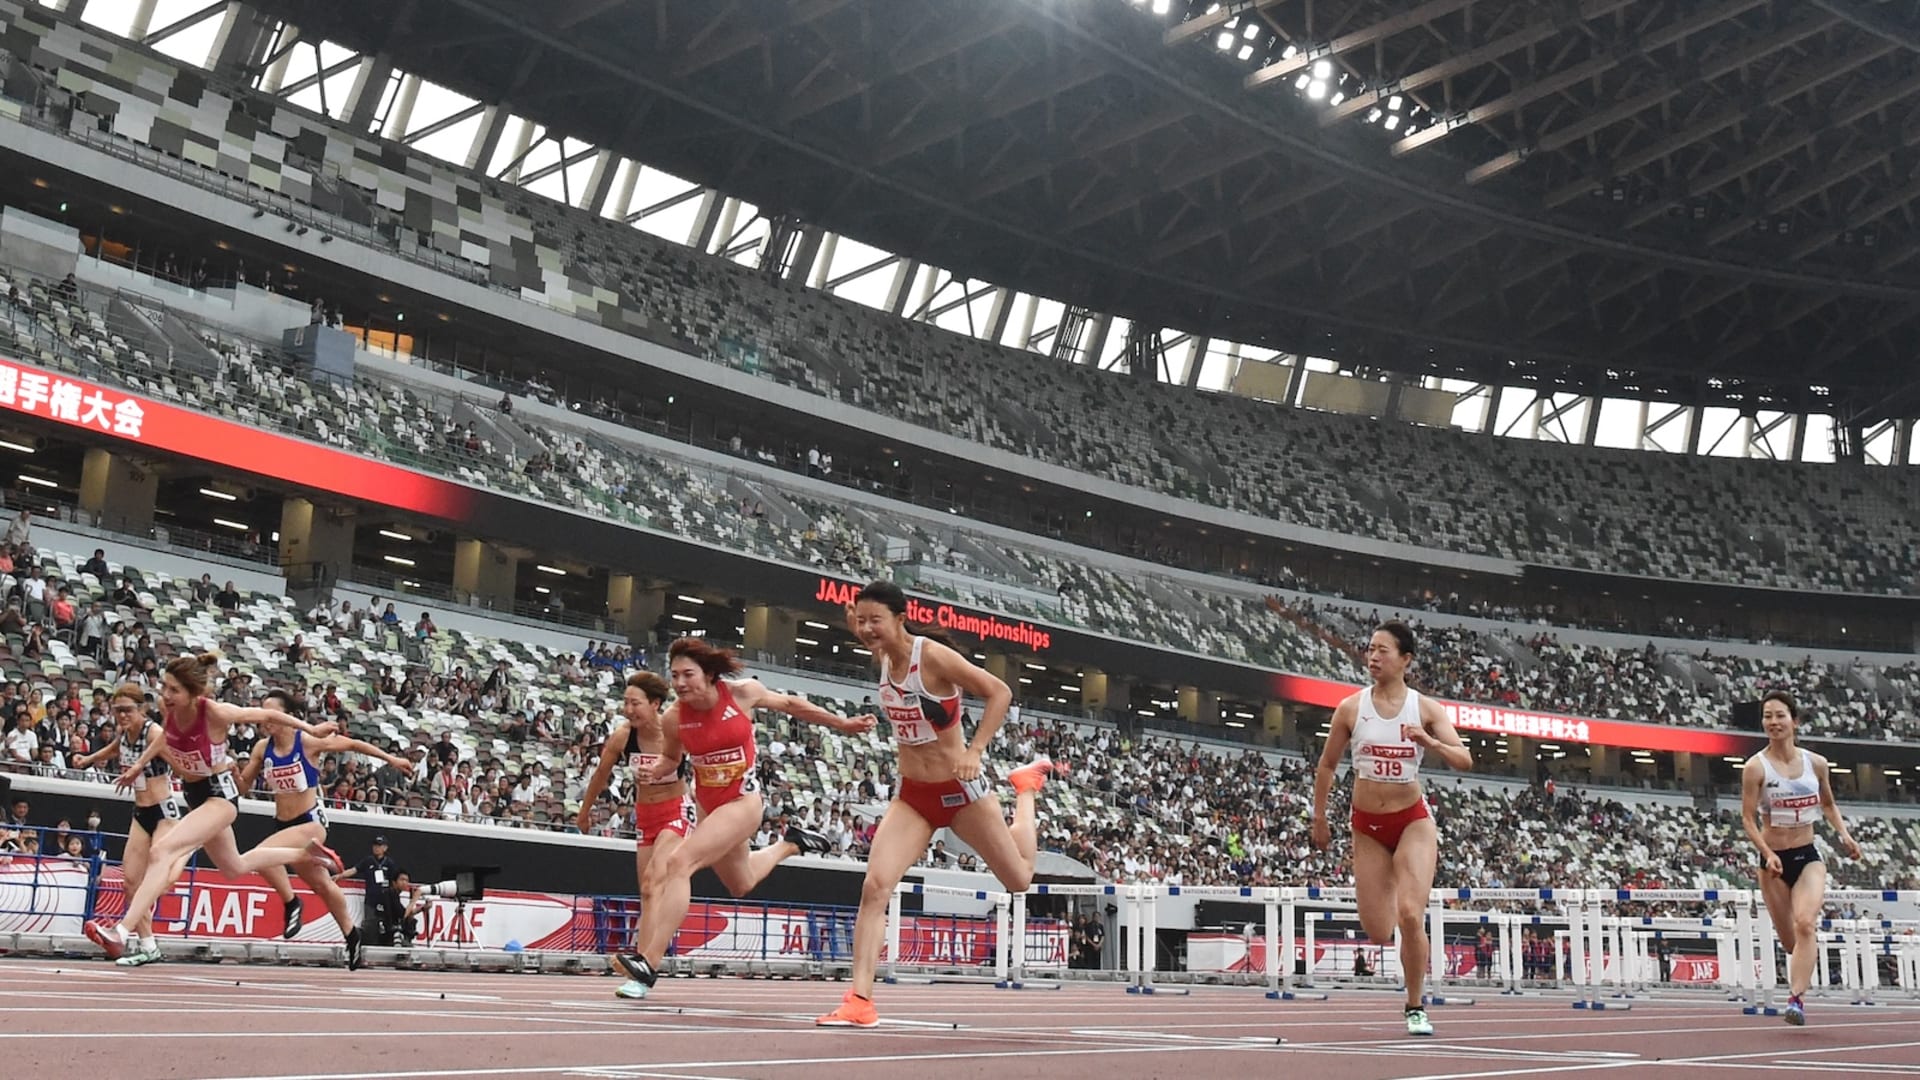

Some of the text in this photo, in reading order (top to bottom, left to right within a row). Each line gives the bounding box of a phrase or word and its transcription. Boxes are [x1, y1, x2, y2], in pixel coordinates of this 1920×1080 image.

[937, 605, 1050, 652] Championships
[897, 723, 919, 739] 37
[1374, 760, 1402, 776] 319
[276, 778, 297, 790] 212
[166, 801, 177, 818] 9
[317, 809, 326, 825] 8
[168, 888, 268, 935] JAAF
[928, 931, 976, 962] JAAF
[1691, 961, 1714, 980] JAAF
